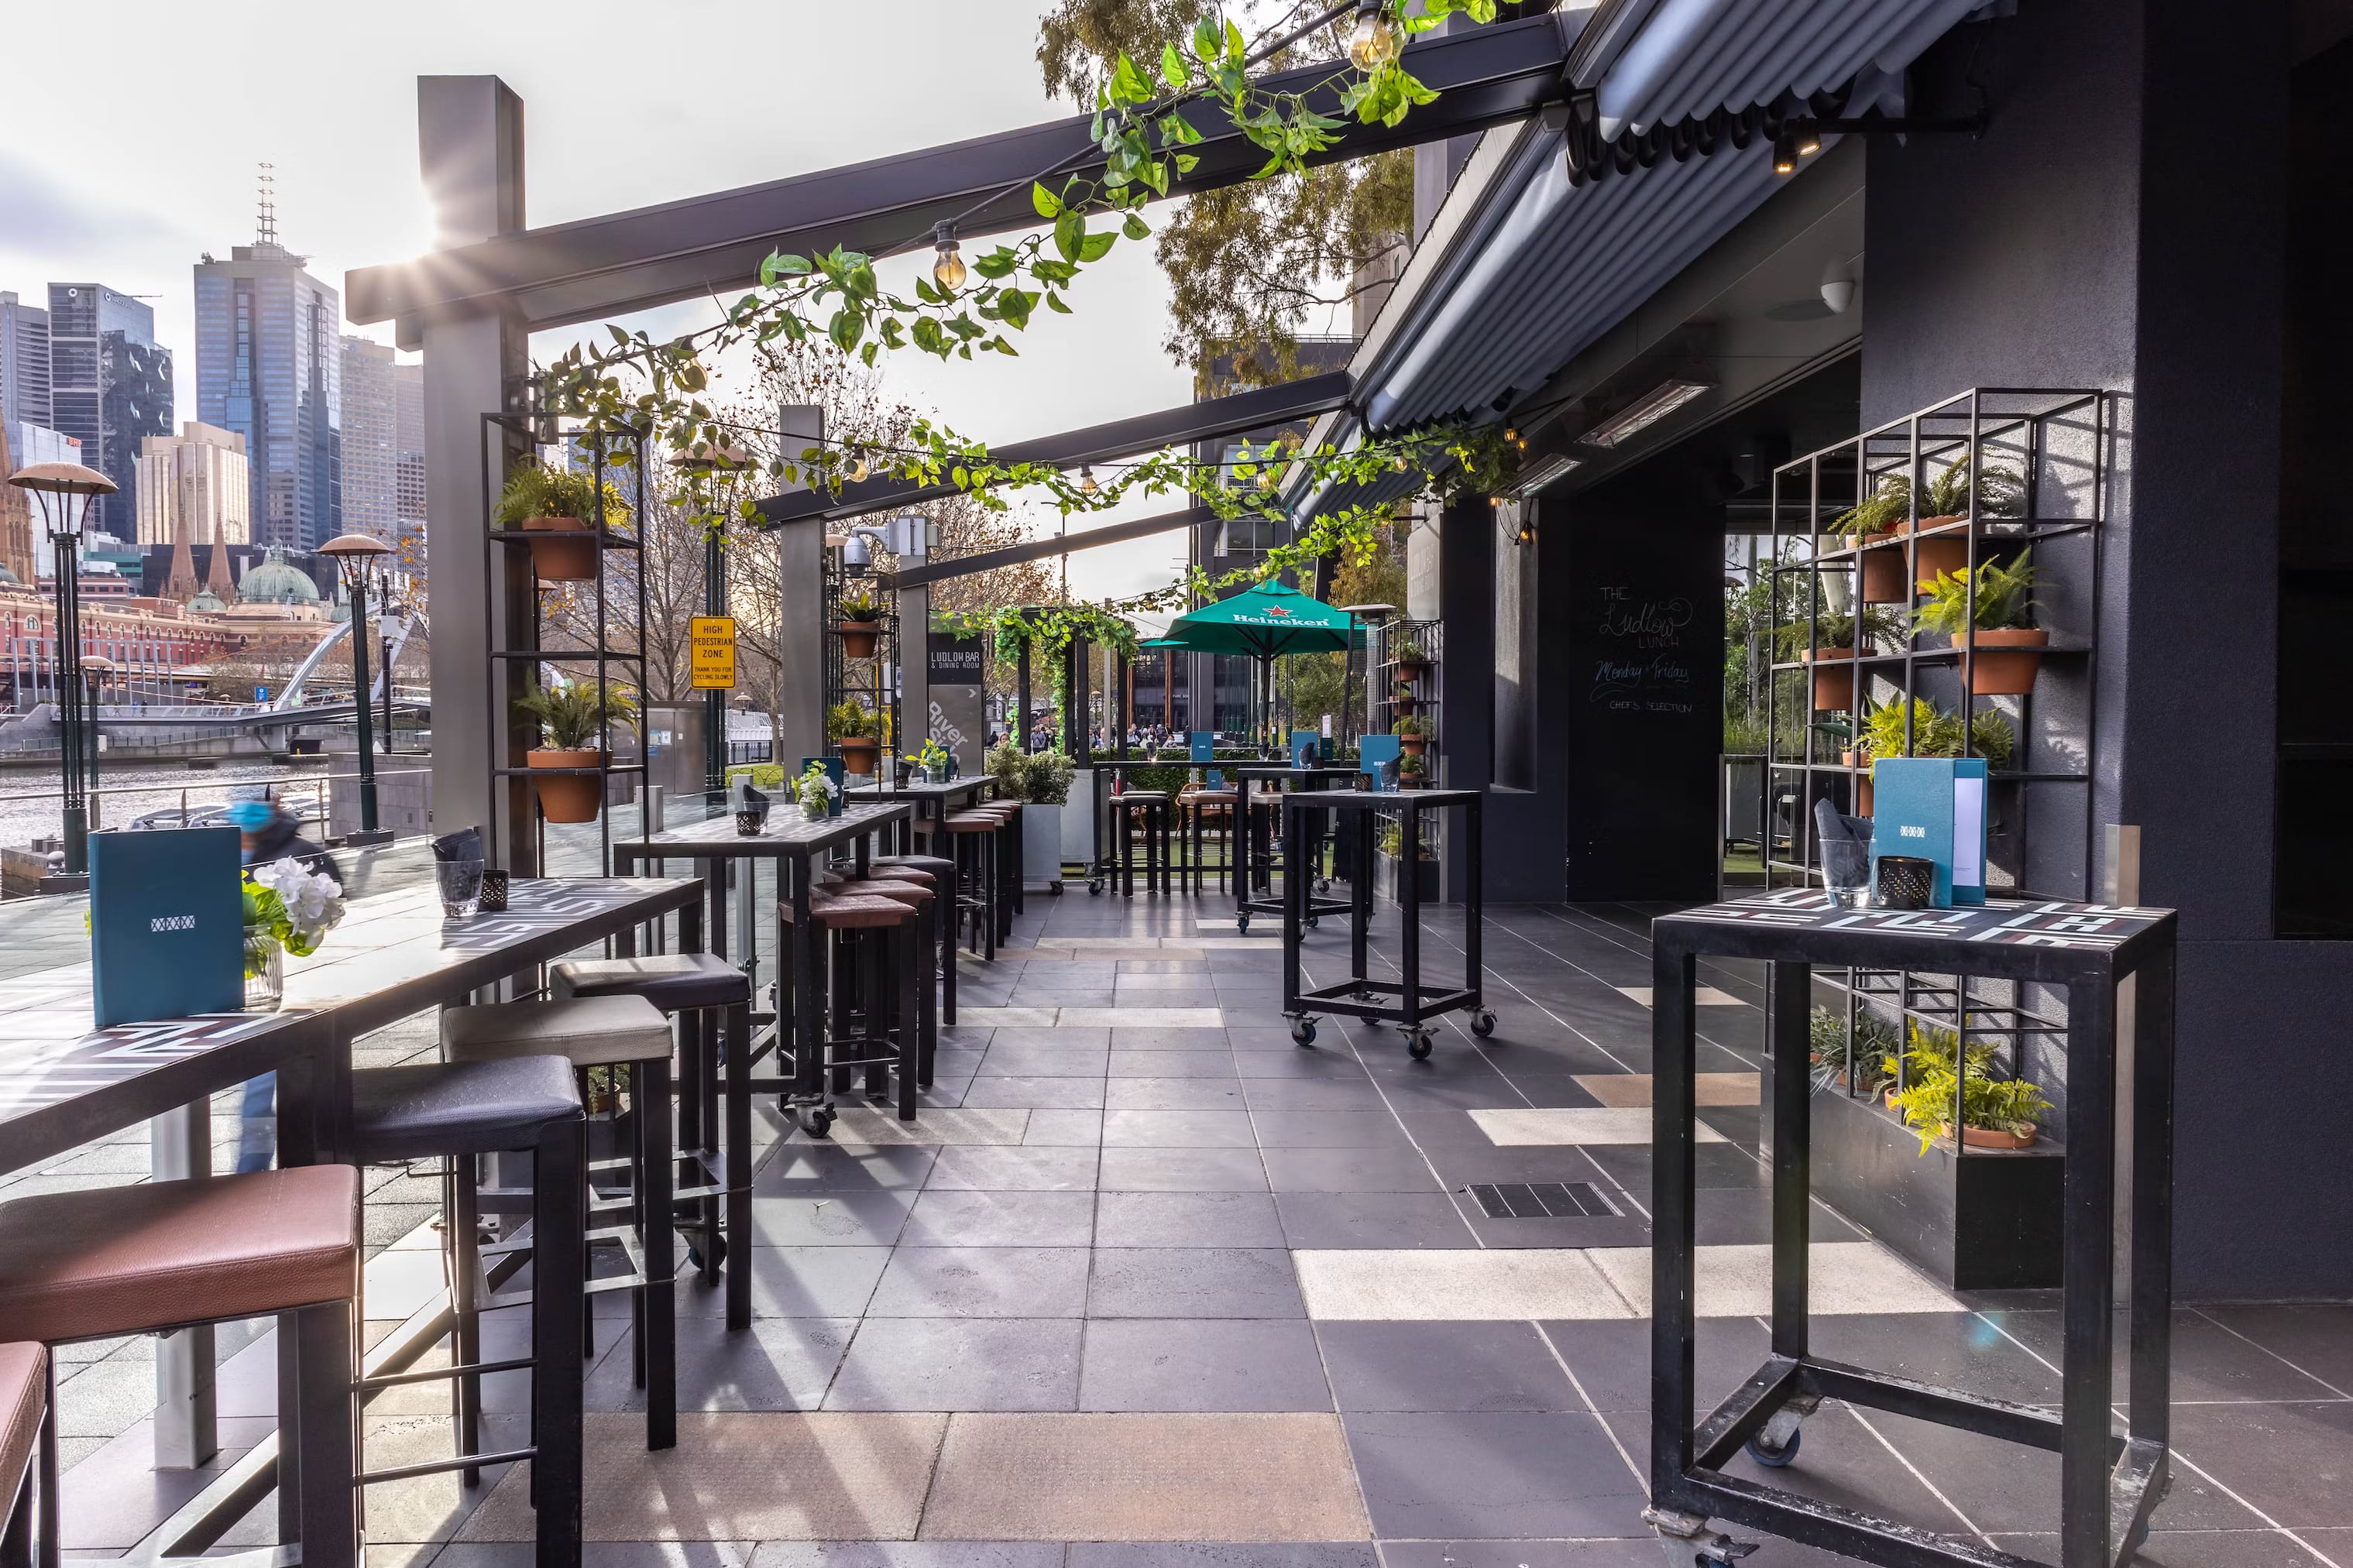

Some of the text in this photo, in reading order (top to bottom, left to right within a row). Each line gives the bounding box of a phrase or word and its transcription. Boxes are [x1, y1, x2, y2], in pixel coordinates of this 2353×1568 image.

[68, 437, 82, 447] BHP
[1599, 586, 1630, 601] THE
[1232, 614, 1330, 626] Heineken
[1599, 597, 1693, 637] Ludlow
[703, 625, 723, 633] HIGH
[693, 637, 733, 646] PEDESTRIAN
[1638, 636, 1679, 649] LUNCH
[702, 650, 723, 658] ZONE
[931, 651, 980, 662] LUDLOW BAR
[1596, 660, 1642, 684] Monday
[1650, 652, 1689, 683] Friday
[1647, 702, 1692, 713] SELECTION
[929, 701, 969, 746] River
[929, 727, 960, 765] Si
